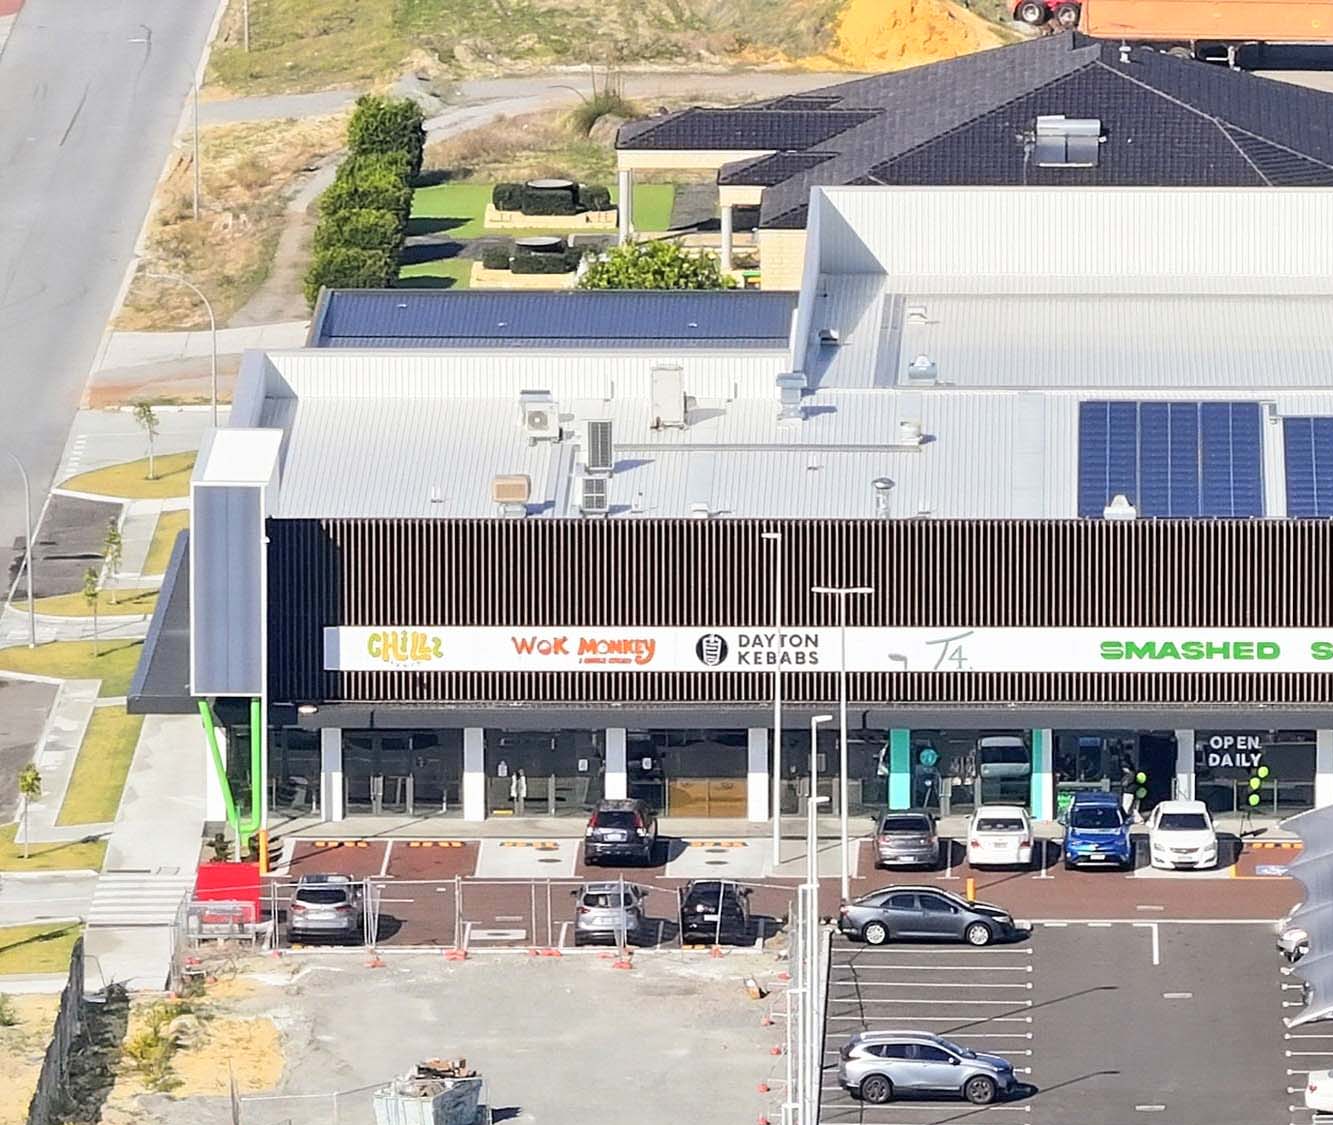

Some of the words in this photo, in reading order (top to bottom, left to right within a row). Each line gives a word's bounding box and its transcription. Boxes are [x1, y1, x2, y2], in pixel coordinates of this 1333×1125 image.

[738, 634, 819, 648] DAYTON
[577, 637, 656, 665] MONKEY
[738, 651, 819, 665] KEBABS
[1100, 641, 1281, 661] SMASHED
[1210, 736, 1261, 749] OPEN
[1208, 753, 1262, 767] DAILY
